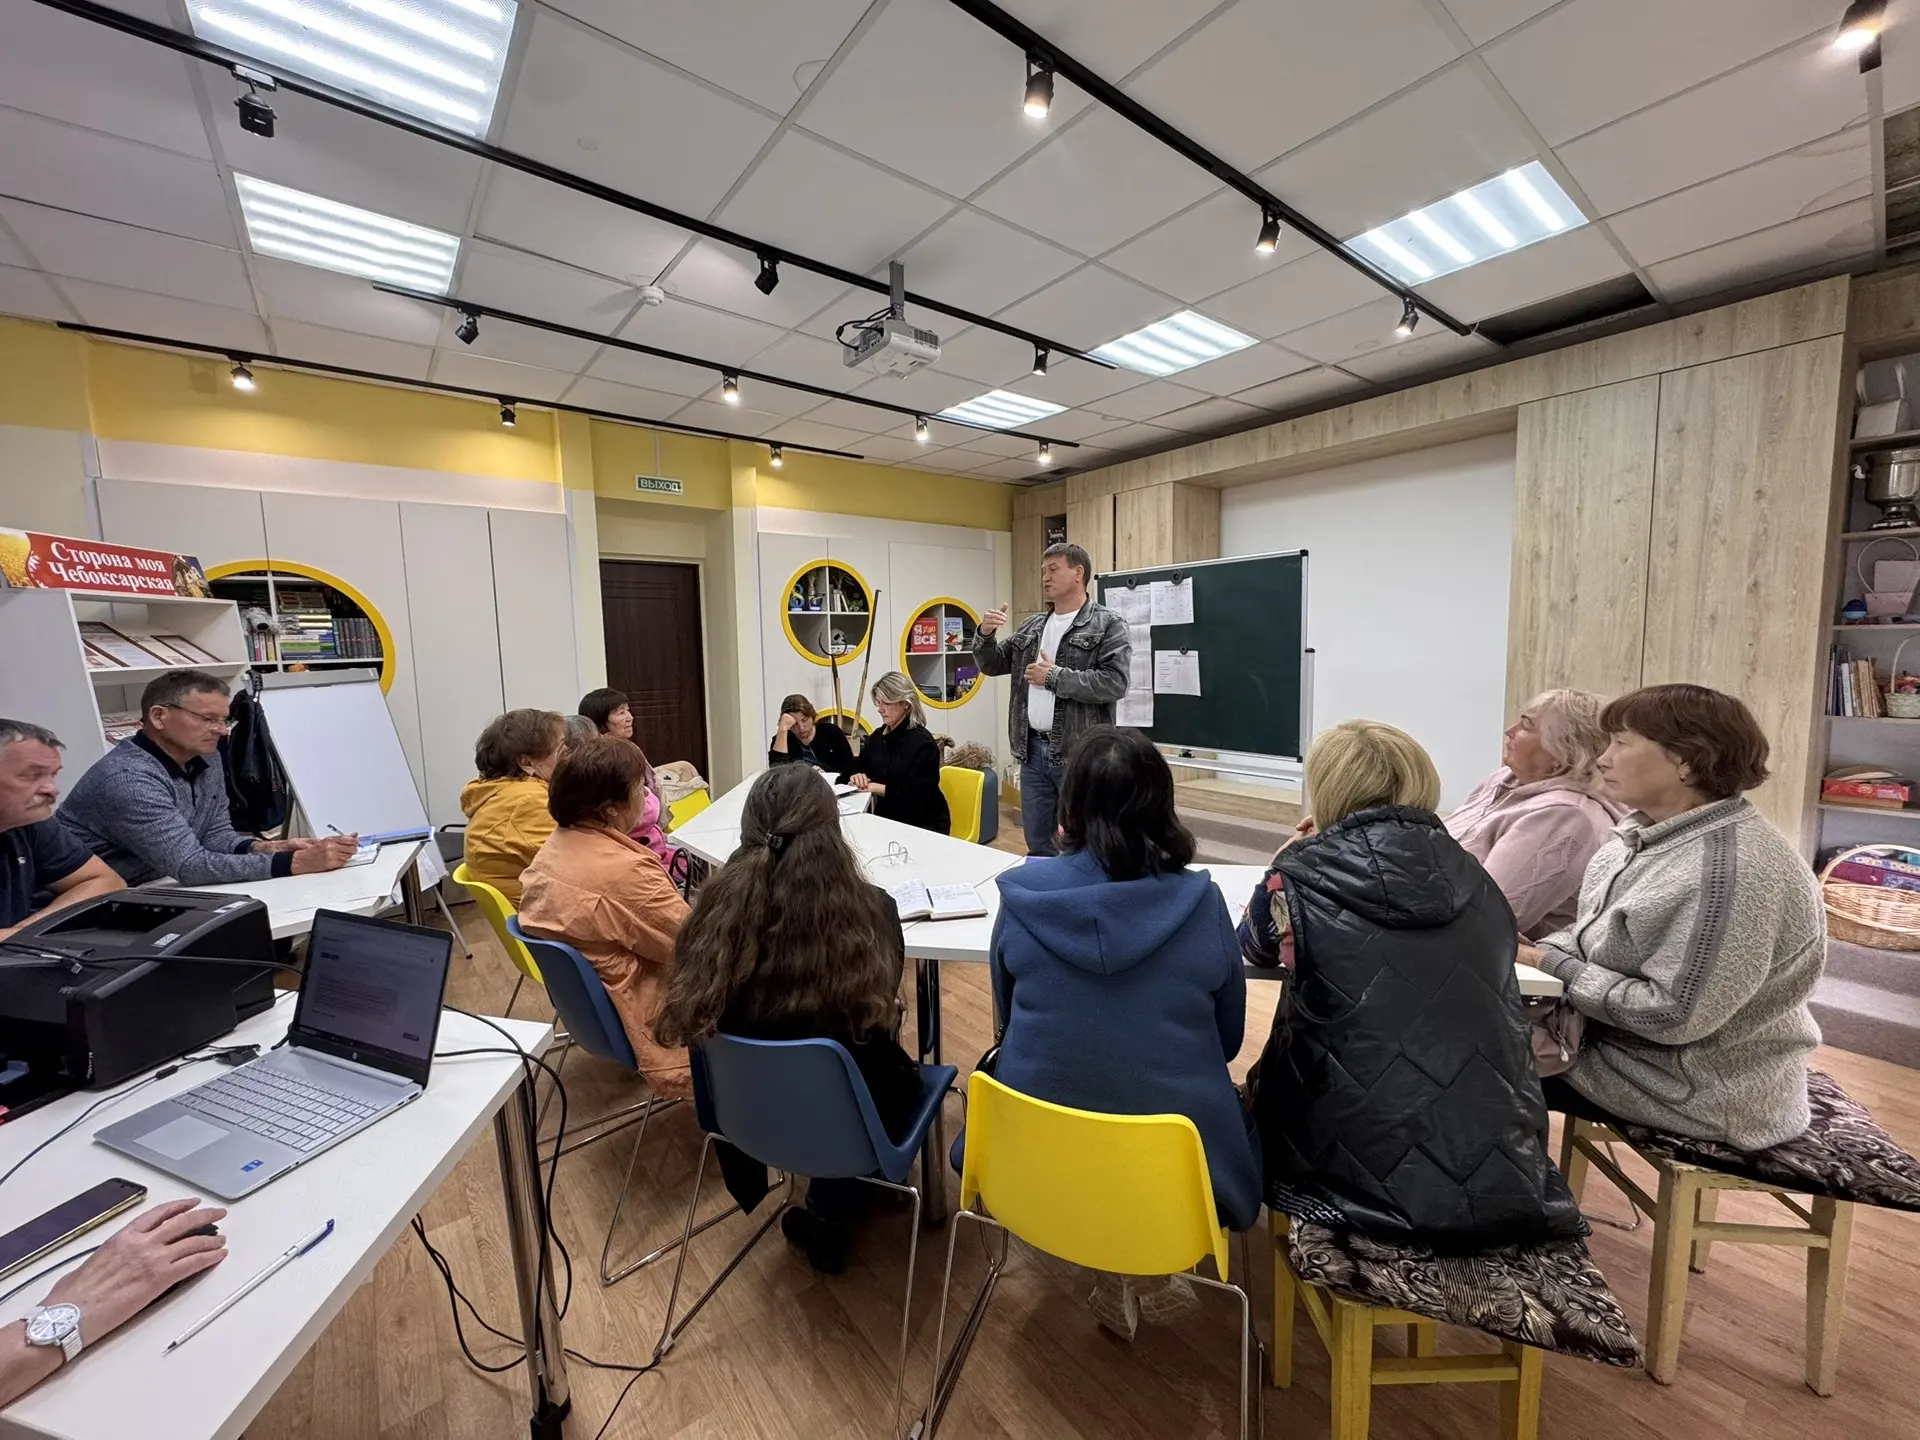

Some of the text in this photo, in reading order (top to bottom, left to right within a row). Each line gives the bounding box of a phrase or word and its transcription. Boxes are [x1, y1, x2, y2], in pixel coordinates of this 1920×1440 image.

[640, 478, 680, 492] ВЫХОД
[50, 541, 167, 573] Сторона моя
[47, 561, 175, 592] Чебоксарская
